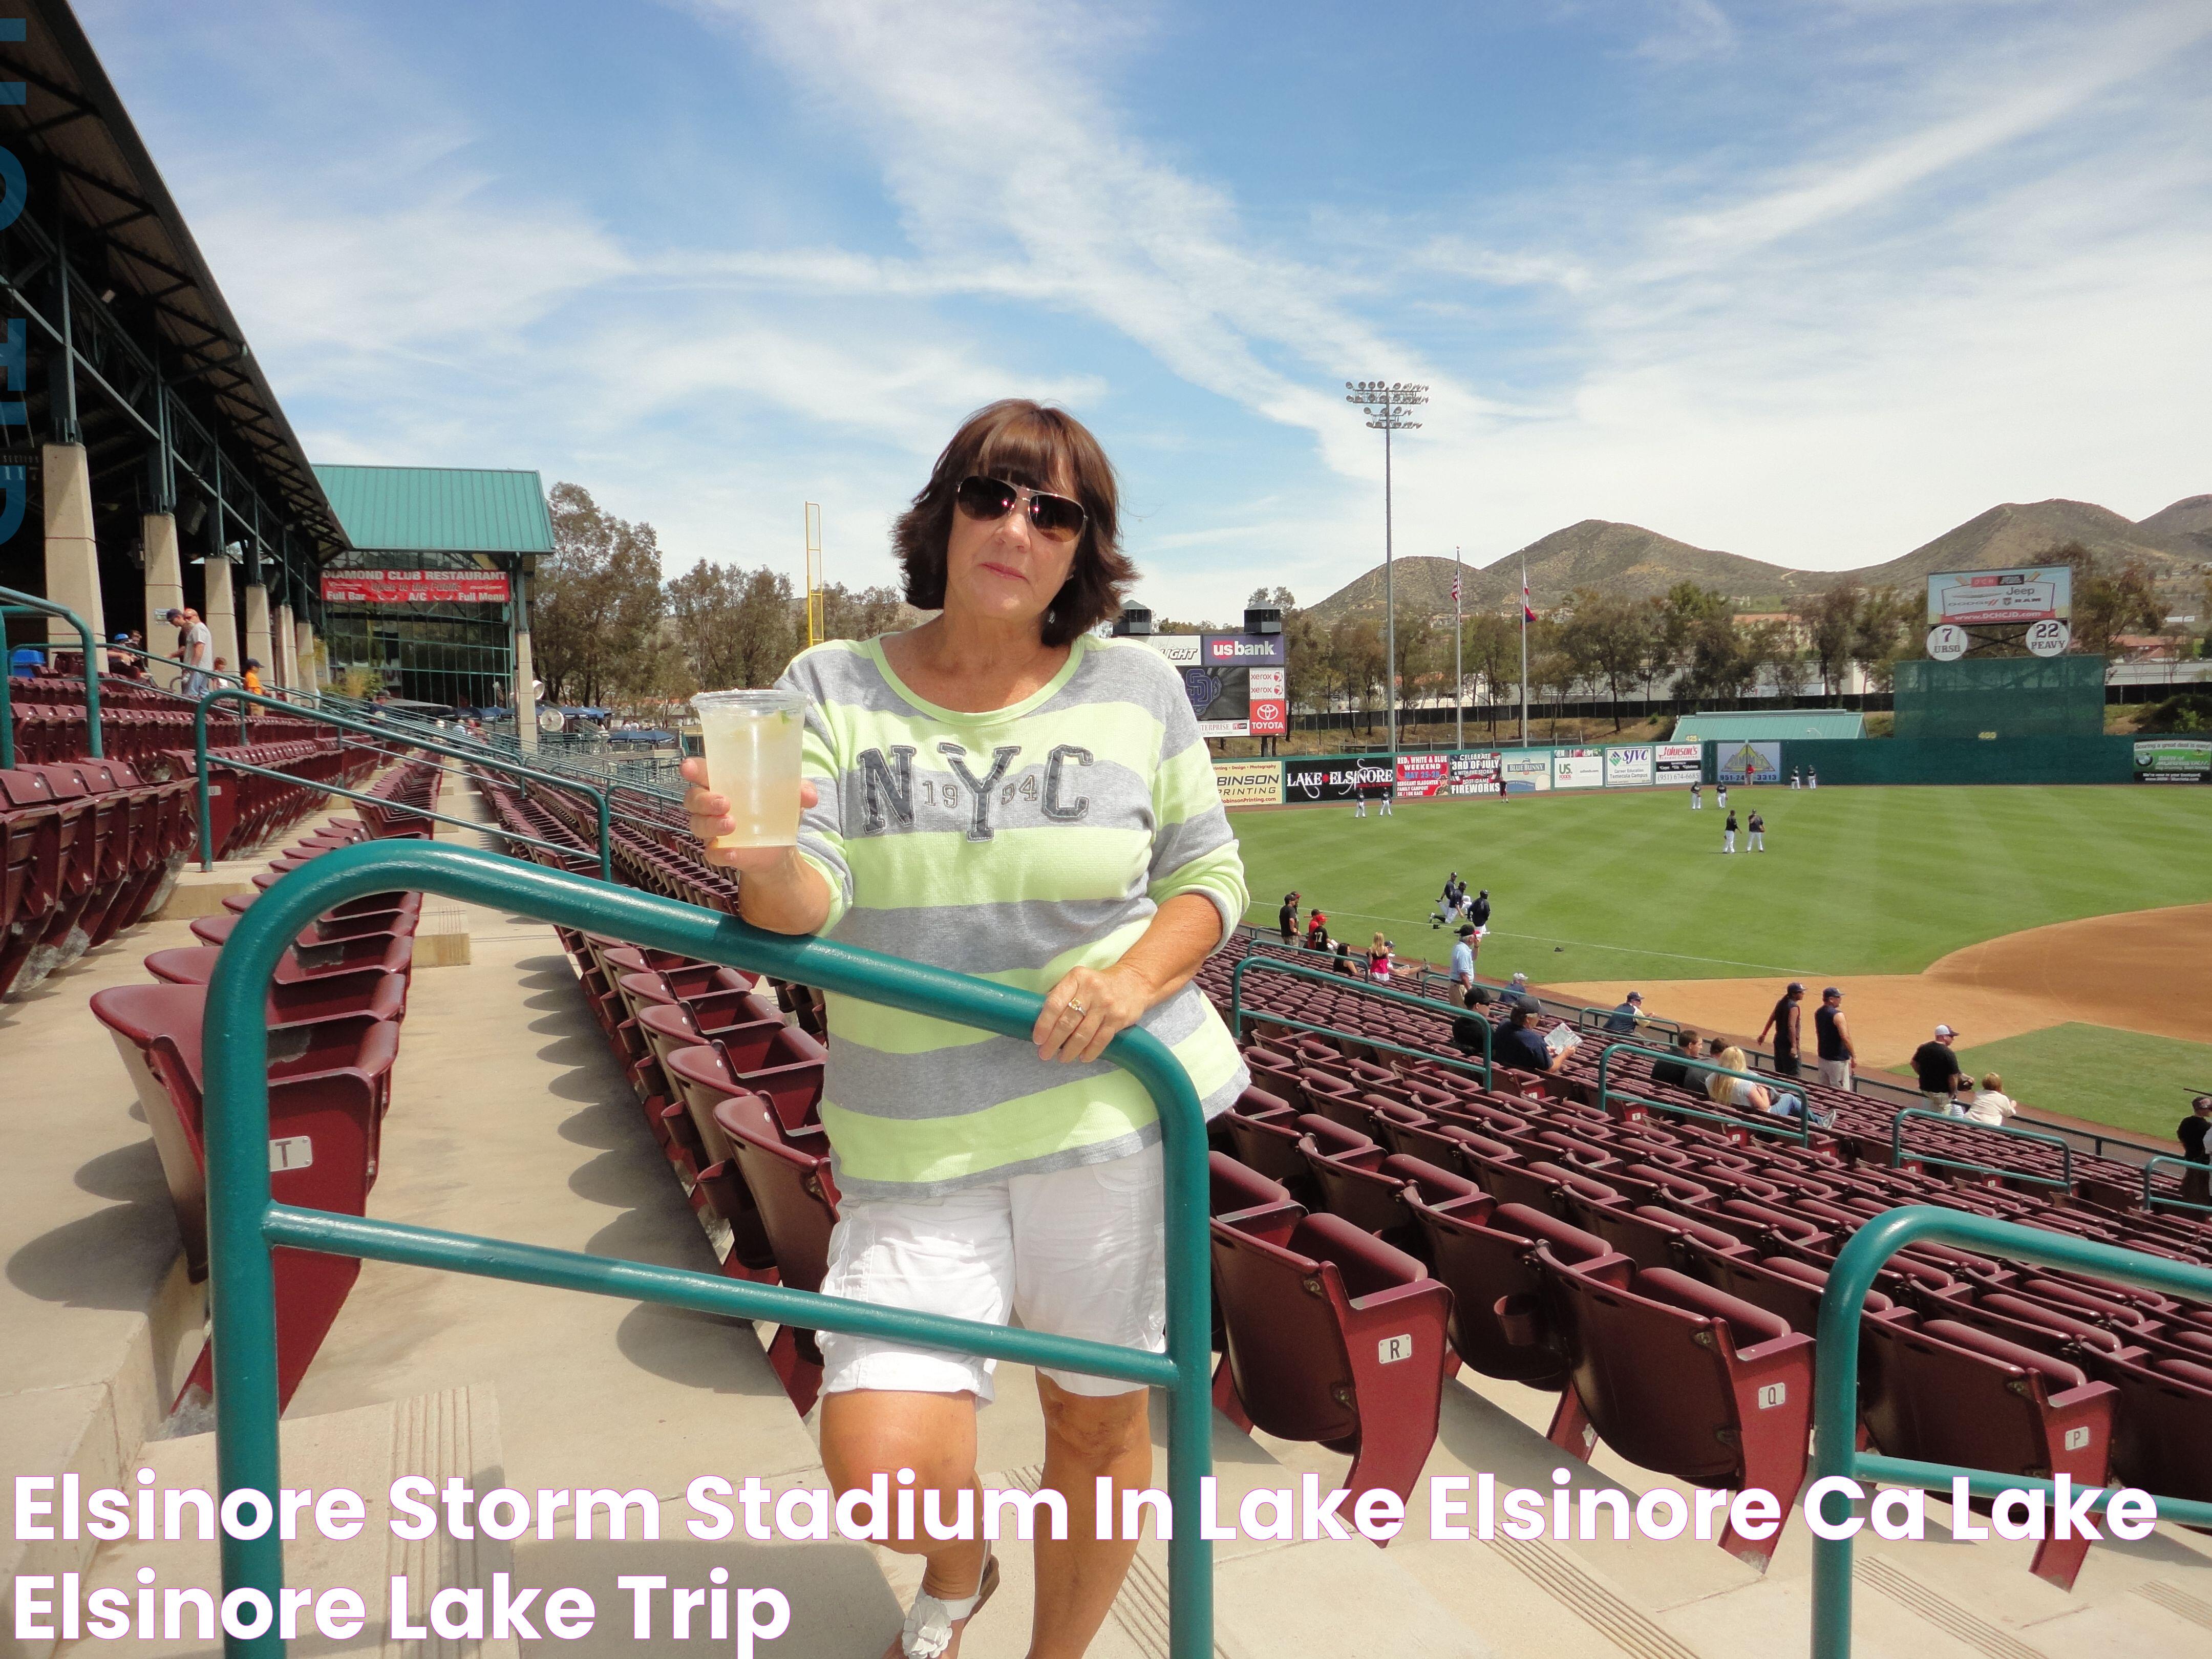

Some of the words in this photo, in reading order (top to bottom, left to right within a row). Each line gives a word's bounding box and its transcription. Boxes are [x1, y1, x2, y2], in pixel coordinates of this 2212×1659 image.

[323, 570, 383, 580] DIAMOND
[388, 571, 421, 580] CLUB
[426, 571, 506, 580] RESTAURANT
[327, 591, 346, 600] Full
[349, 592, 366, 601] Bar
[408, 592, 427, 601] A/C
[458, 592, 477, 601] Full
[479, 592, 506, 601] Menu
[2006, 587, 2035, 596] Jeep
[1954, 611, 2041, 621] www.DCHCJD.com
[1942, 628, 1952, 643] 7
[2036, 623, 2059, 639] 22
[2031, 640, 2066, 650] PEAVY
[1623, 749, 1648, 764] SJVC
[1452, 760, 1469, 770] 3RD
[1471, 759, 1481, 770] OF
[1482, 759, 1499, 769] JULY
[1287, 772, 1323, 795] LAKE
[1329, 763, 1393, 792] ELSINORE
[1657, 774, 1672, 782] (951)
[1451, 782, 1500, 794] FIREWORKS
[274, 1140, 292, 1168] T
[1390, 1338, 1401, 1360] R
[1768, 1387, 1777, 1405] Q
[2073, 1431, 2081, 1448] P
